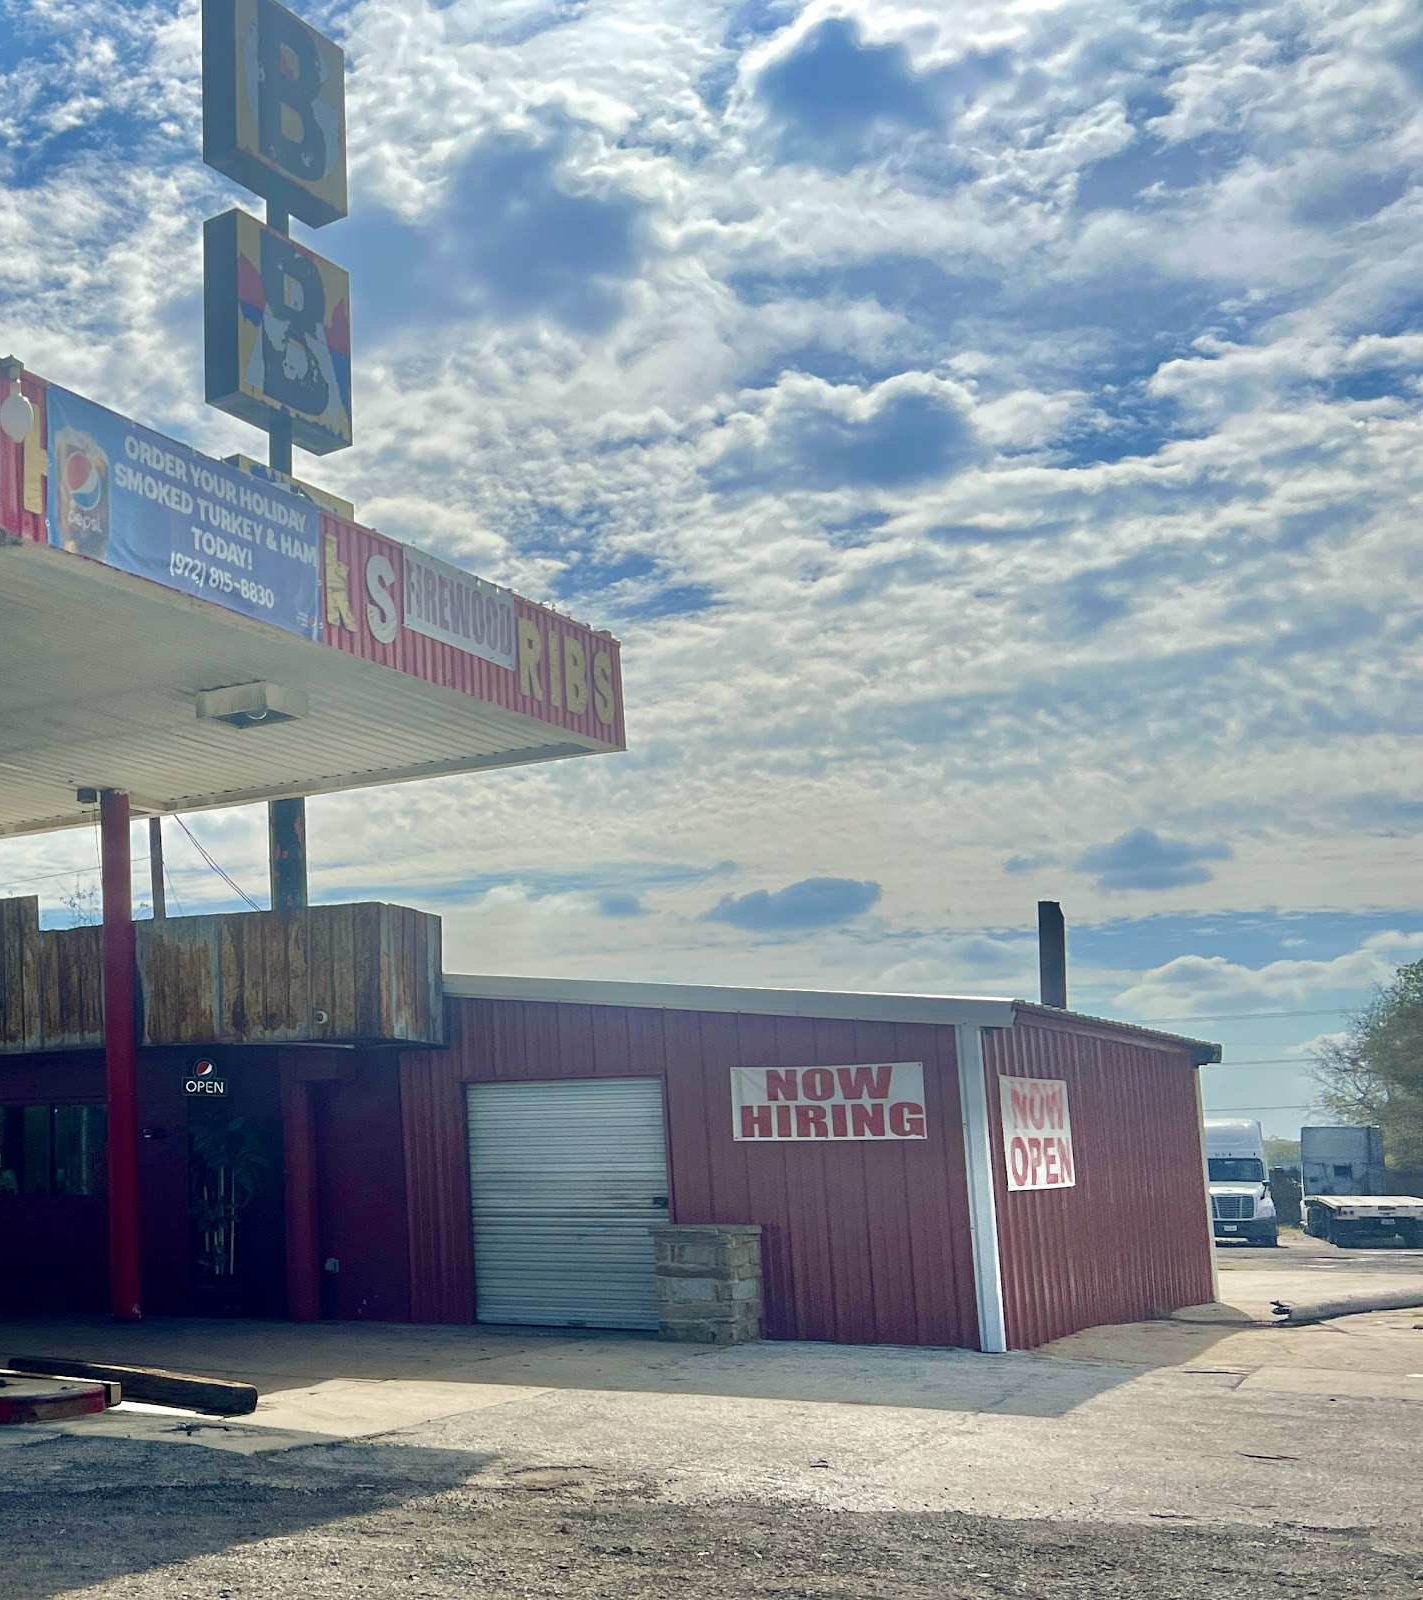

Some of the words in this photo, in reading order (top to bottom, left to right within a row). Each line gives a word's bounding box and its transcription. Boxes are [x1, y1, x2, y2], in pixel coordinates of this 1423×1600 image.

[124, 435, 187, 482] ORDER
[189, 463, 237, 504] YOUR
[240, 486, 306, 533] HOLIDAY
[115, 463, 193, 515] SMOKED
[197, 498, 262, 544] TURKEY
[266, 528, 278, 551] &
[281, 535, 319, 567] HAM
[191, 526, 253, 570] TODAY!
[170, 551, 206, 588] (972)
[208, 568, 274, 609] 815-8830
[405, 558, 513, 656] FIREWOOD
[518, 616, 615, 725] RIBS
[185, 1080, 224, 1094] OPEN
[766, 1066, 893, 1102] NOW
[1010, 1080, 1064, 1130] NOW
[740, 1102, 924, 1138] HIRING
[1010, 1136, 1073, 1186] OPEN
